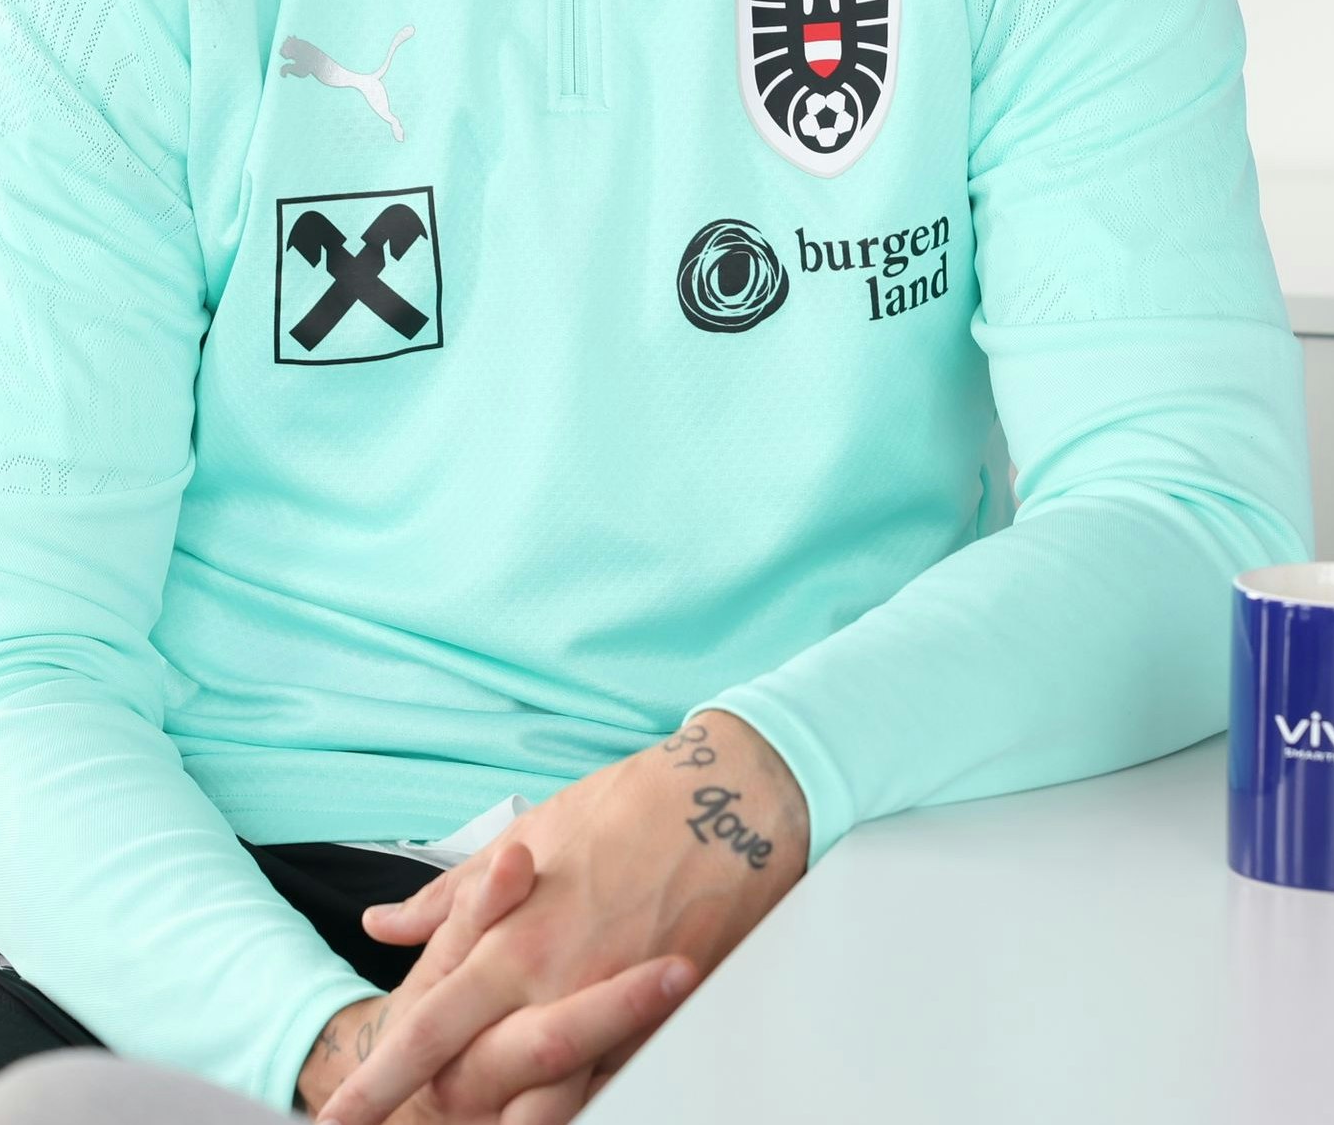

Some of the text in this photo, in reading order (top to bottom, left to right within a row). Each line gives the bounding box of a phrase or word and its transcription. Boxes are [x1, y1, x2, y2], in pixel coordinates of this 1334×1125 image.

[795, 216, 950, 278] burgen
[865, 251, 949, 321] land
[686, 786, 774, 870] Love
